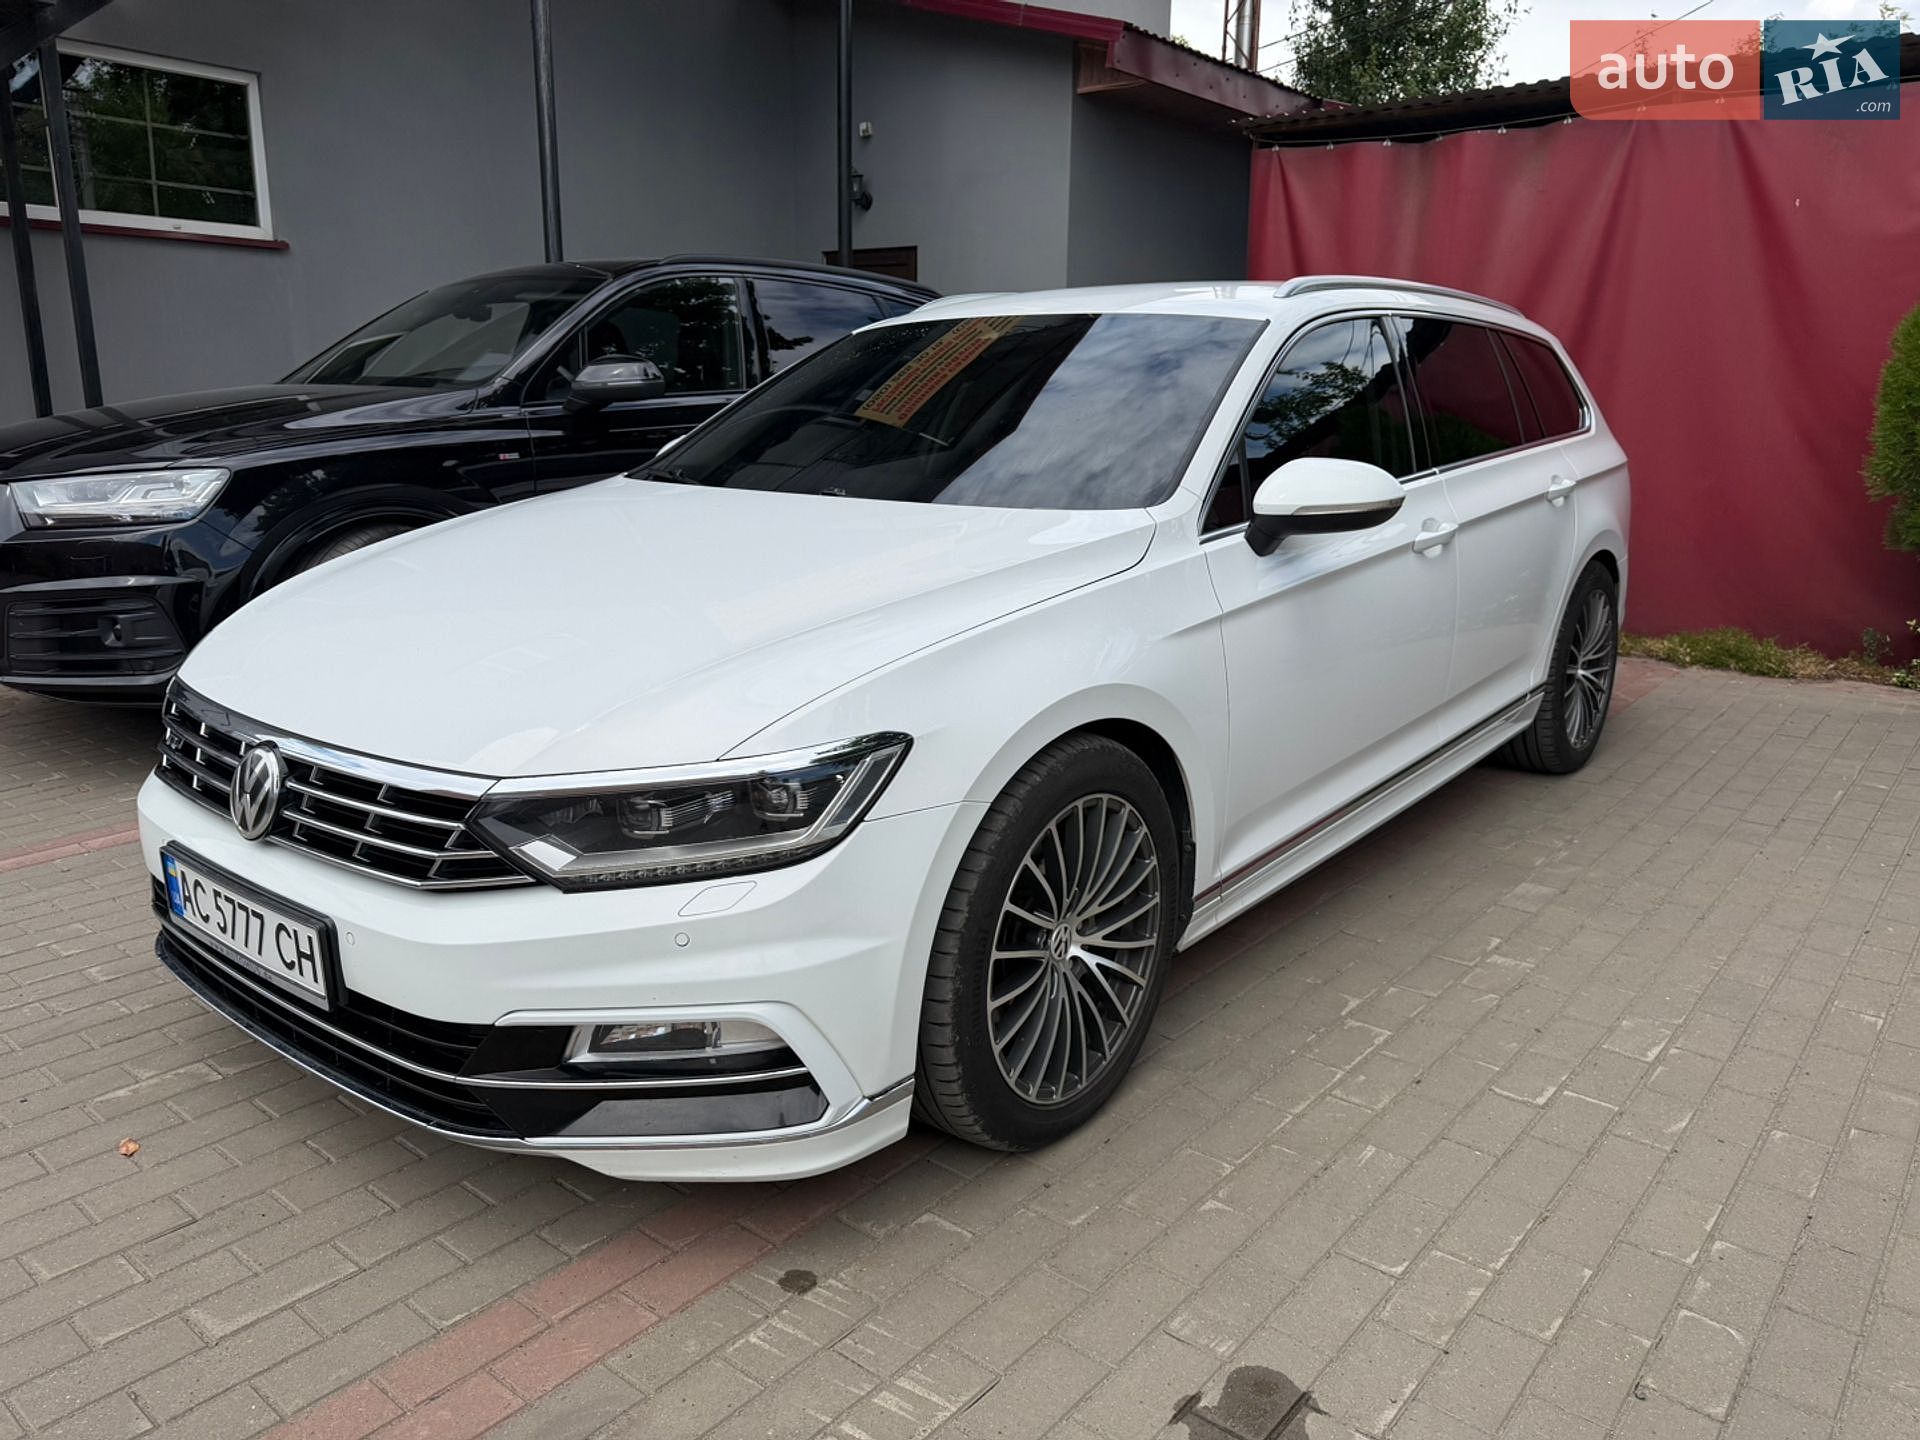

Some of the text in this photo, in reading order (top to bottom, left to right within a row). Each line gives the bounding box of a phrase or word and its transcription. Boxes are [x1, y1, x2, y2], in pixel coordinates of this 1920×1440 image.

[180, 870, 210, 924] AC
[212, 888, 265, 957] 5777
[274, 922, 319, 984] CH
